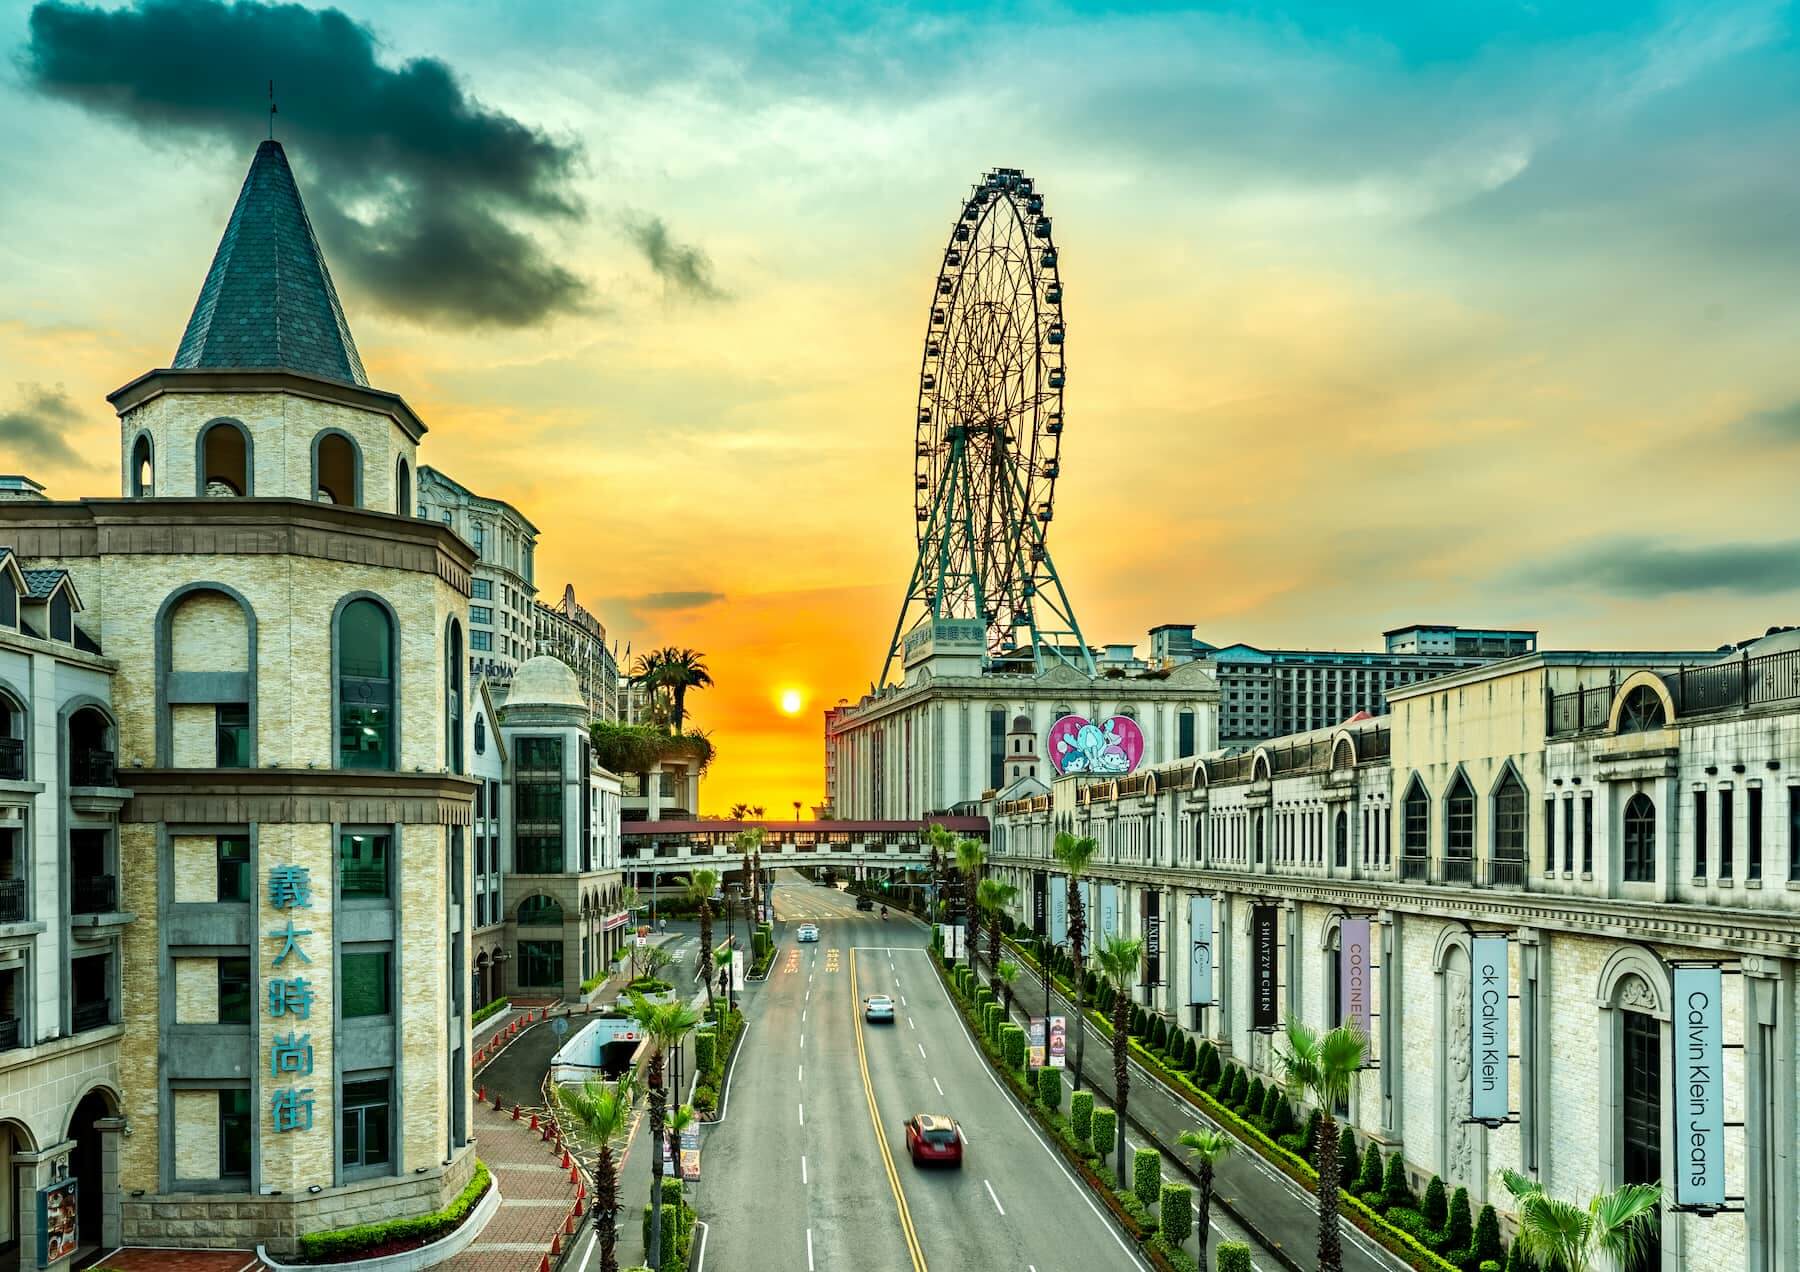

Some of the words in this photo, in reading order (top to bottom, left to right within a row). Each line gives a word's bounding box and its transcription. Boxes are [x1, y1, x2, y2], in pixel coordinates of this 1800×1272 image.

[485, 662, 514, 678] ROYA
[1148, 915, 1159, 954] LUXURY
[1261, 921, 1270, 968] SHIATZY
[1261, 980, 1270, 1011] CHEN
[1482, 964, 1499, 985] ck
[268, 864, 316, 1133] 義大時尚街
[1482, 990, 1499, 1046] Calvin
[1688, 991, 1709, 1060] Calvin
[1482, 1050, 1499, 1091] Klein
[1689, 1065, 1710, 1115] Klein
[1690, 1121, 1711, 1186] Jeans
